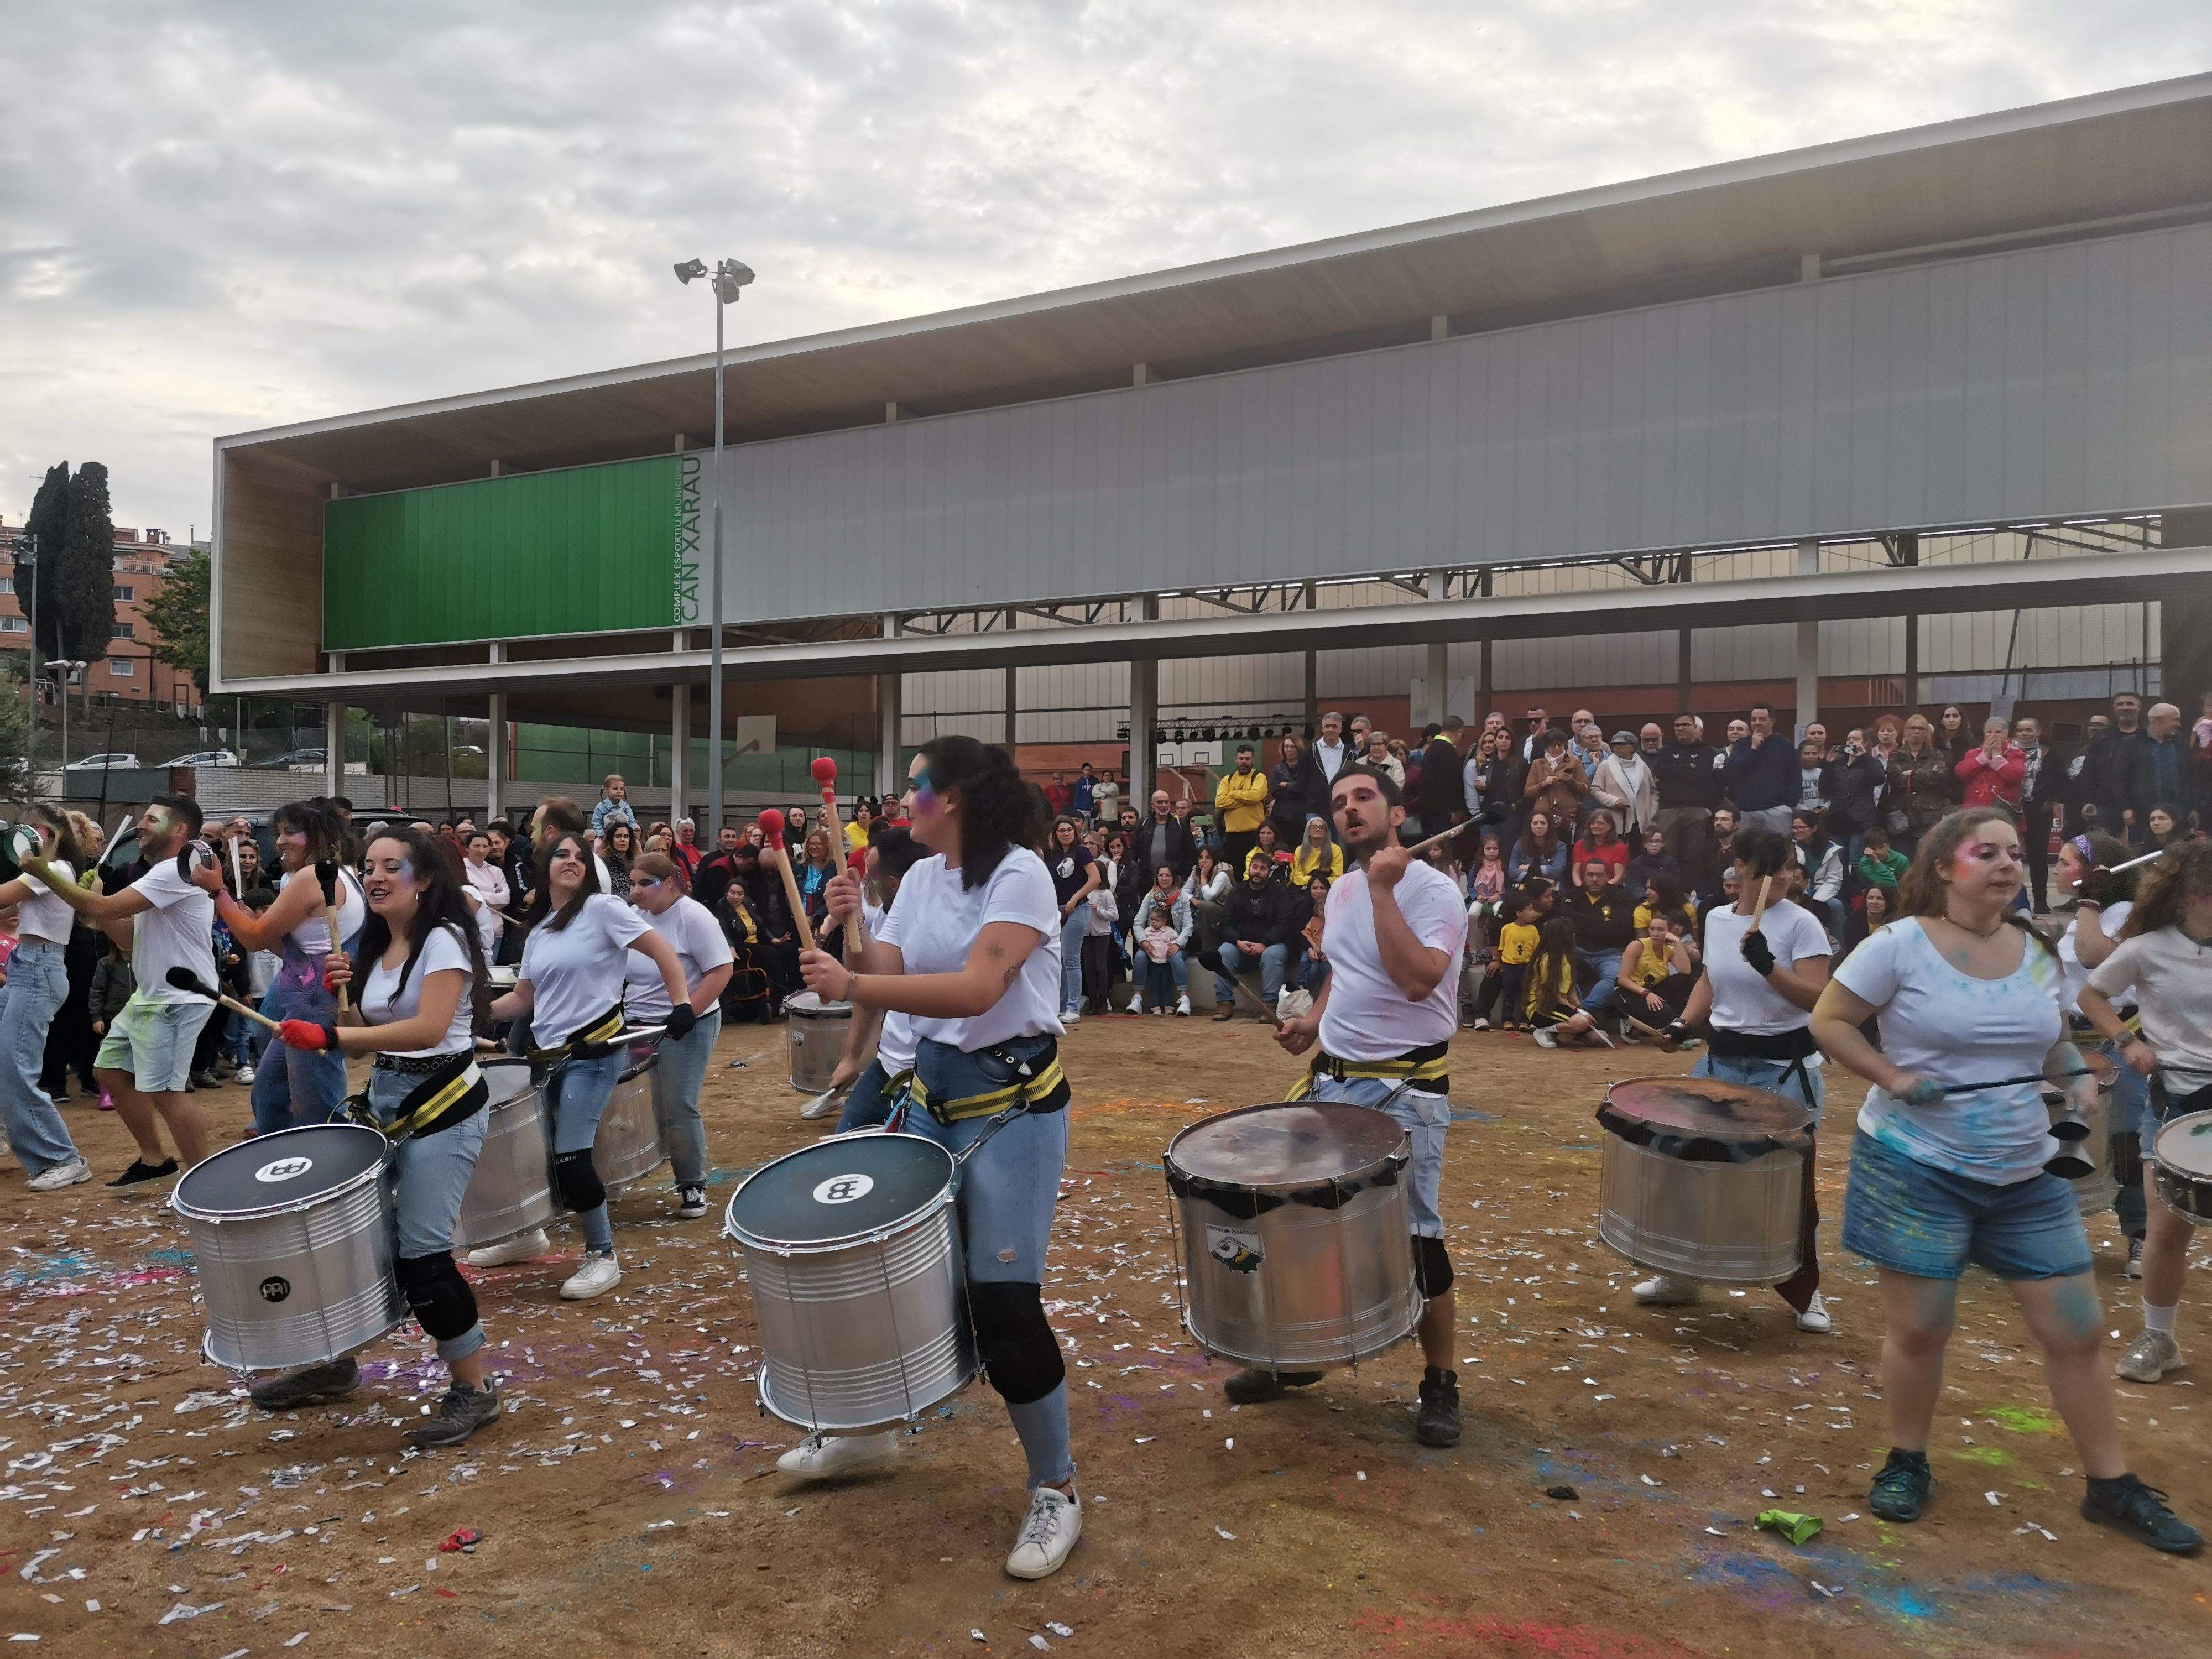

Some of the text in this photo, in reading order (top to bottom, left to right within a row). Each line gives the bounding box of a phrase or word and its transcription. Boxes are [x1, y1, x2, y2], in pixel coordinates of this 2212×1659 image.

[674, 461, 683, 517] MUNICIPAL
[674, 520, 682, 570] ESPORTIU
[681, 457, 701, 621] CAN XARAU
